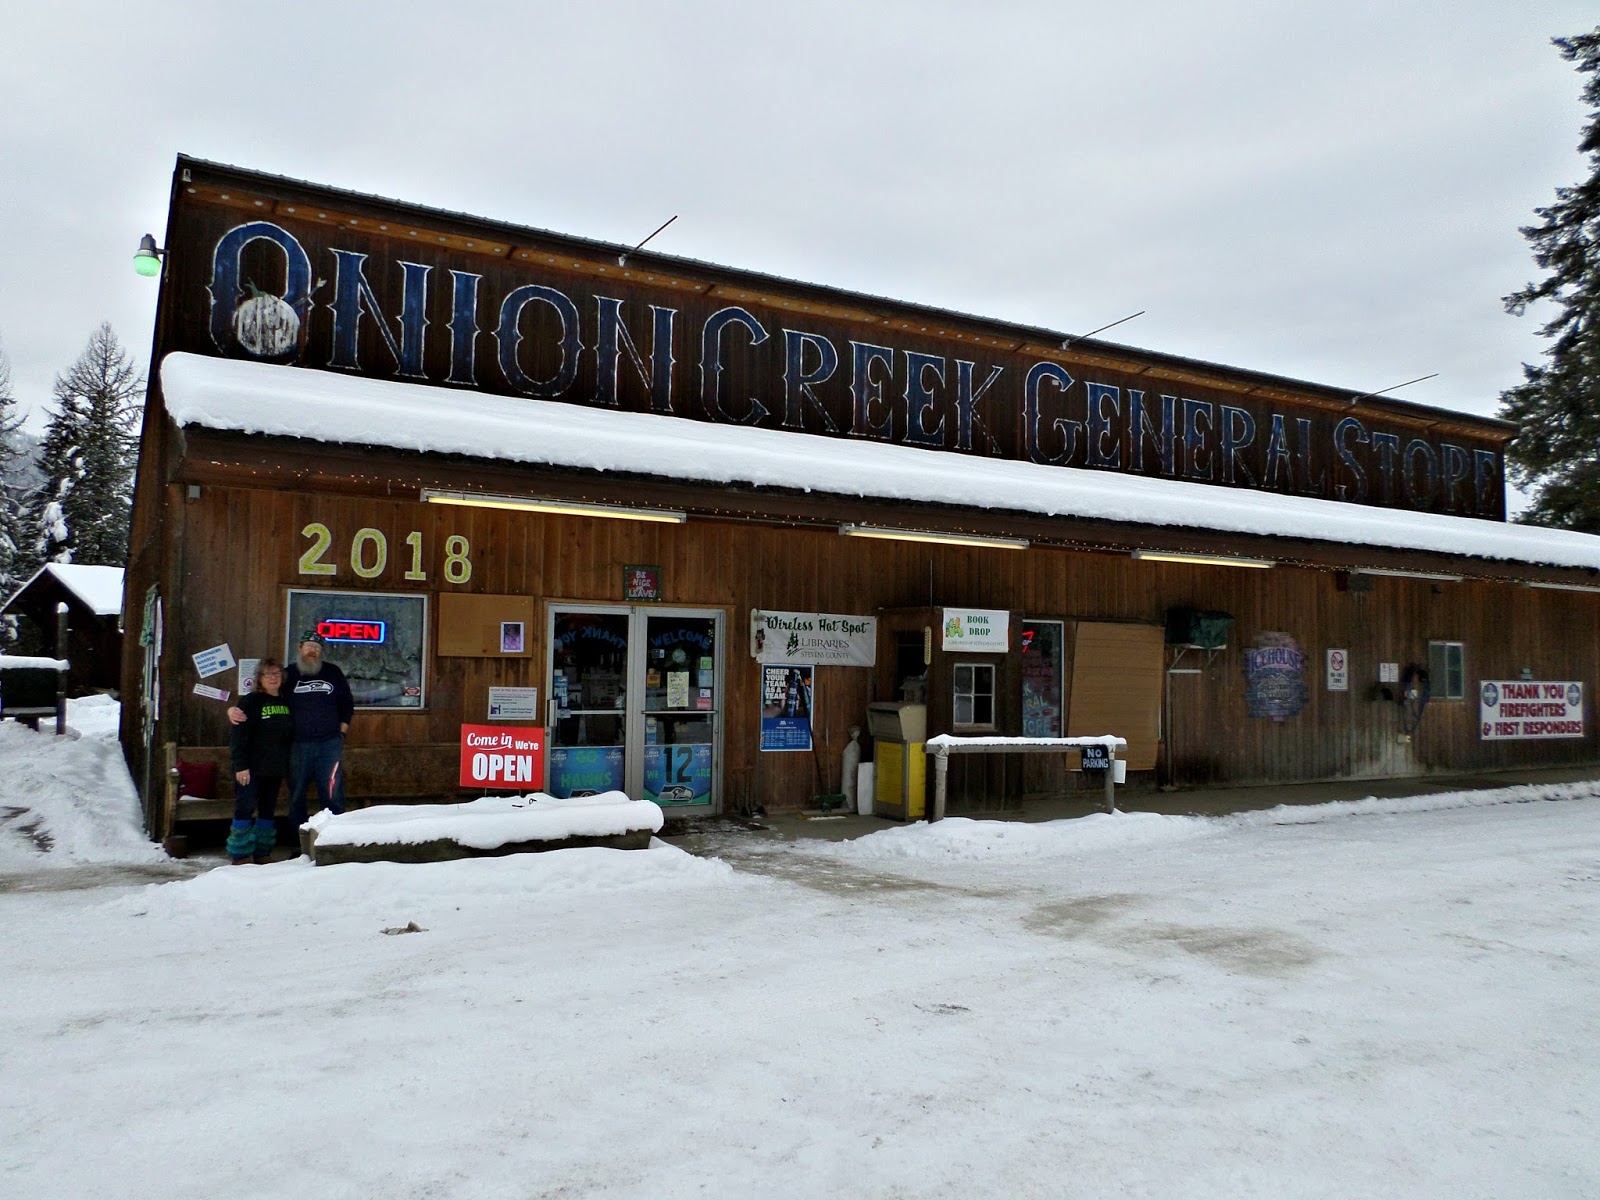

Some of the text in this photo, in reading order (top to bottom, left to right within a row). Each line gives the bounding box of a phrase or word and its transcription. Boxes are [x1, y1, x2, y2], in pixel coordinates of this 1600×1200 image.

[207, 220, 1496, 517] ONION CREEK GENERAL STORE
[298, 522, 473, 584] 2018
[765, 615, 870, 636] Wireless Hot Spot
[967, 615, 989, 624] BOOK
[317, 622, 380, 640] OPEN
[969, 627, 991, 636] DROP
[651, 629, 711, 650] WELCOME
[801, 637, 850, 650] LIBRARIES
[801, 651, 850, 659] STEVENS COUNTY
[1248, 648, 1302, 676] ICEHOUSE
[1502, 684, 1565, 699] THANK YOU
[1500, 702, 1566, 718] FIREFIGHTERS
[1483, 720, 1582, 736] & FIRST RESPONDERS
[466, 733, 513, 748] Come in
[515, 741, 539, 750] We're
[575, 750, 598, 764] GO
[1087, 748, 1102, 758] NO
[472, 752, 533, 782] OPEN
[663, 746, 693, 784] 12
[1082, 758, 1109, 768] PARKING
[560, 771, 612, 787] HAWKS
[647, 770, 660, 779] WE
[695, 768, 711, 778] ARE
